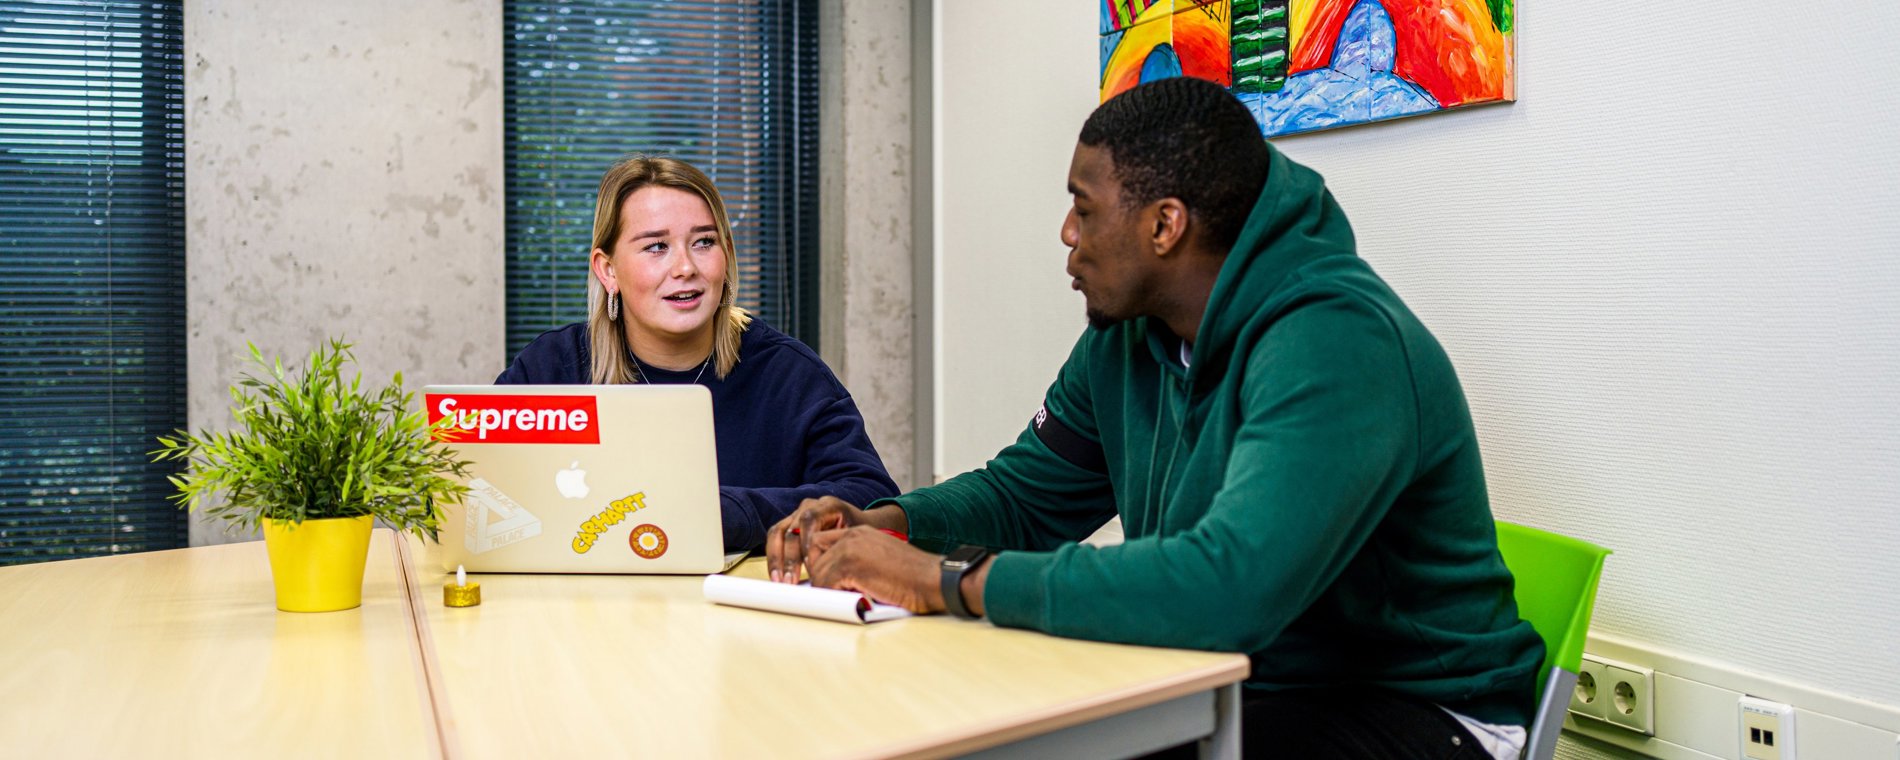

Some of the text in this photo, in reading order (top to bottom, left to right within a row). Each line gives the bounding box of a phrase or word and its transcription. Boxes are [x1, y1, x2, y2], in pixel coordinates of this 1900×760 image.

[438, 398, 588, 439] Supreme
[491, 528, 525, 548] PALACE
[572, 491, 647, 555] CARHARTT
